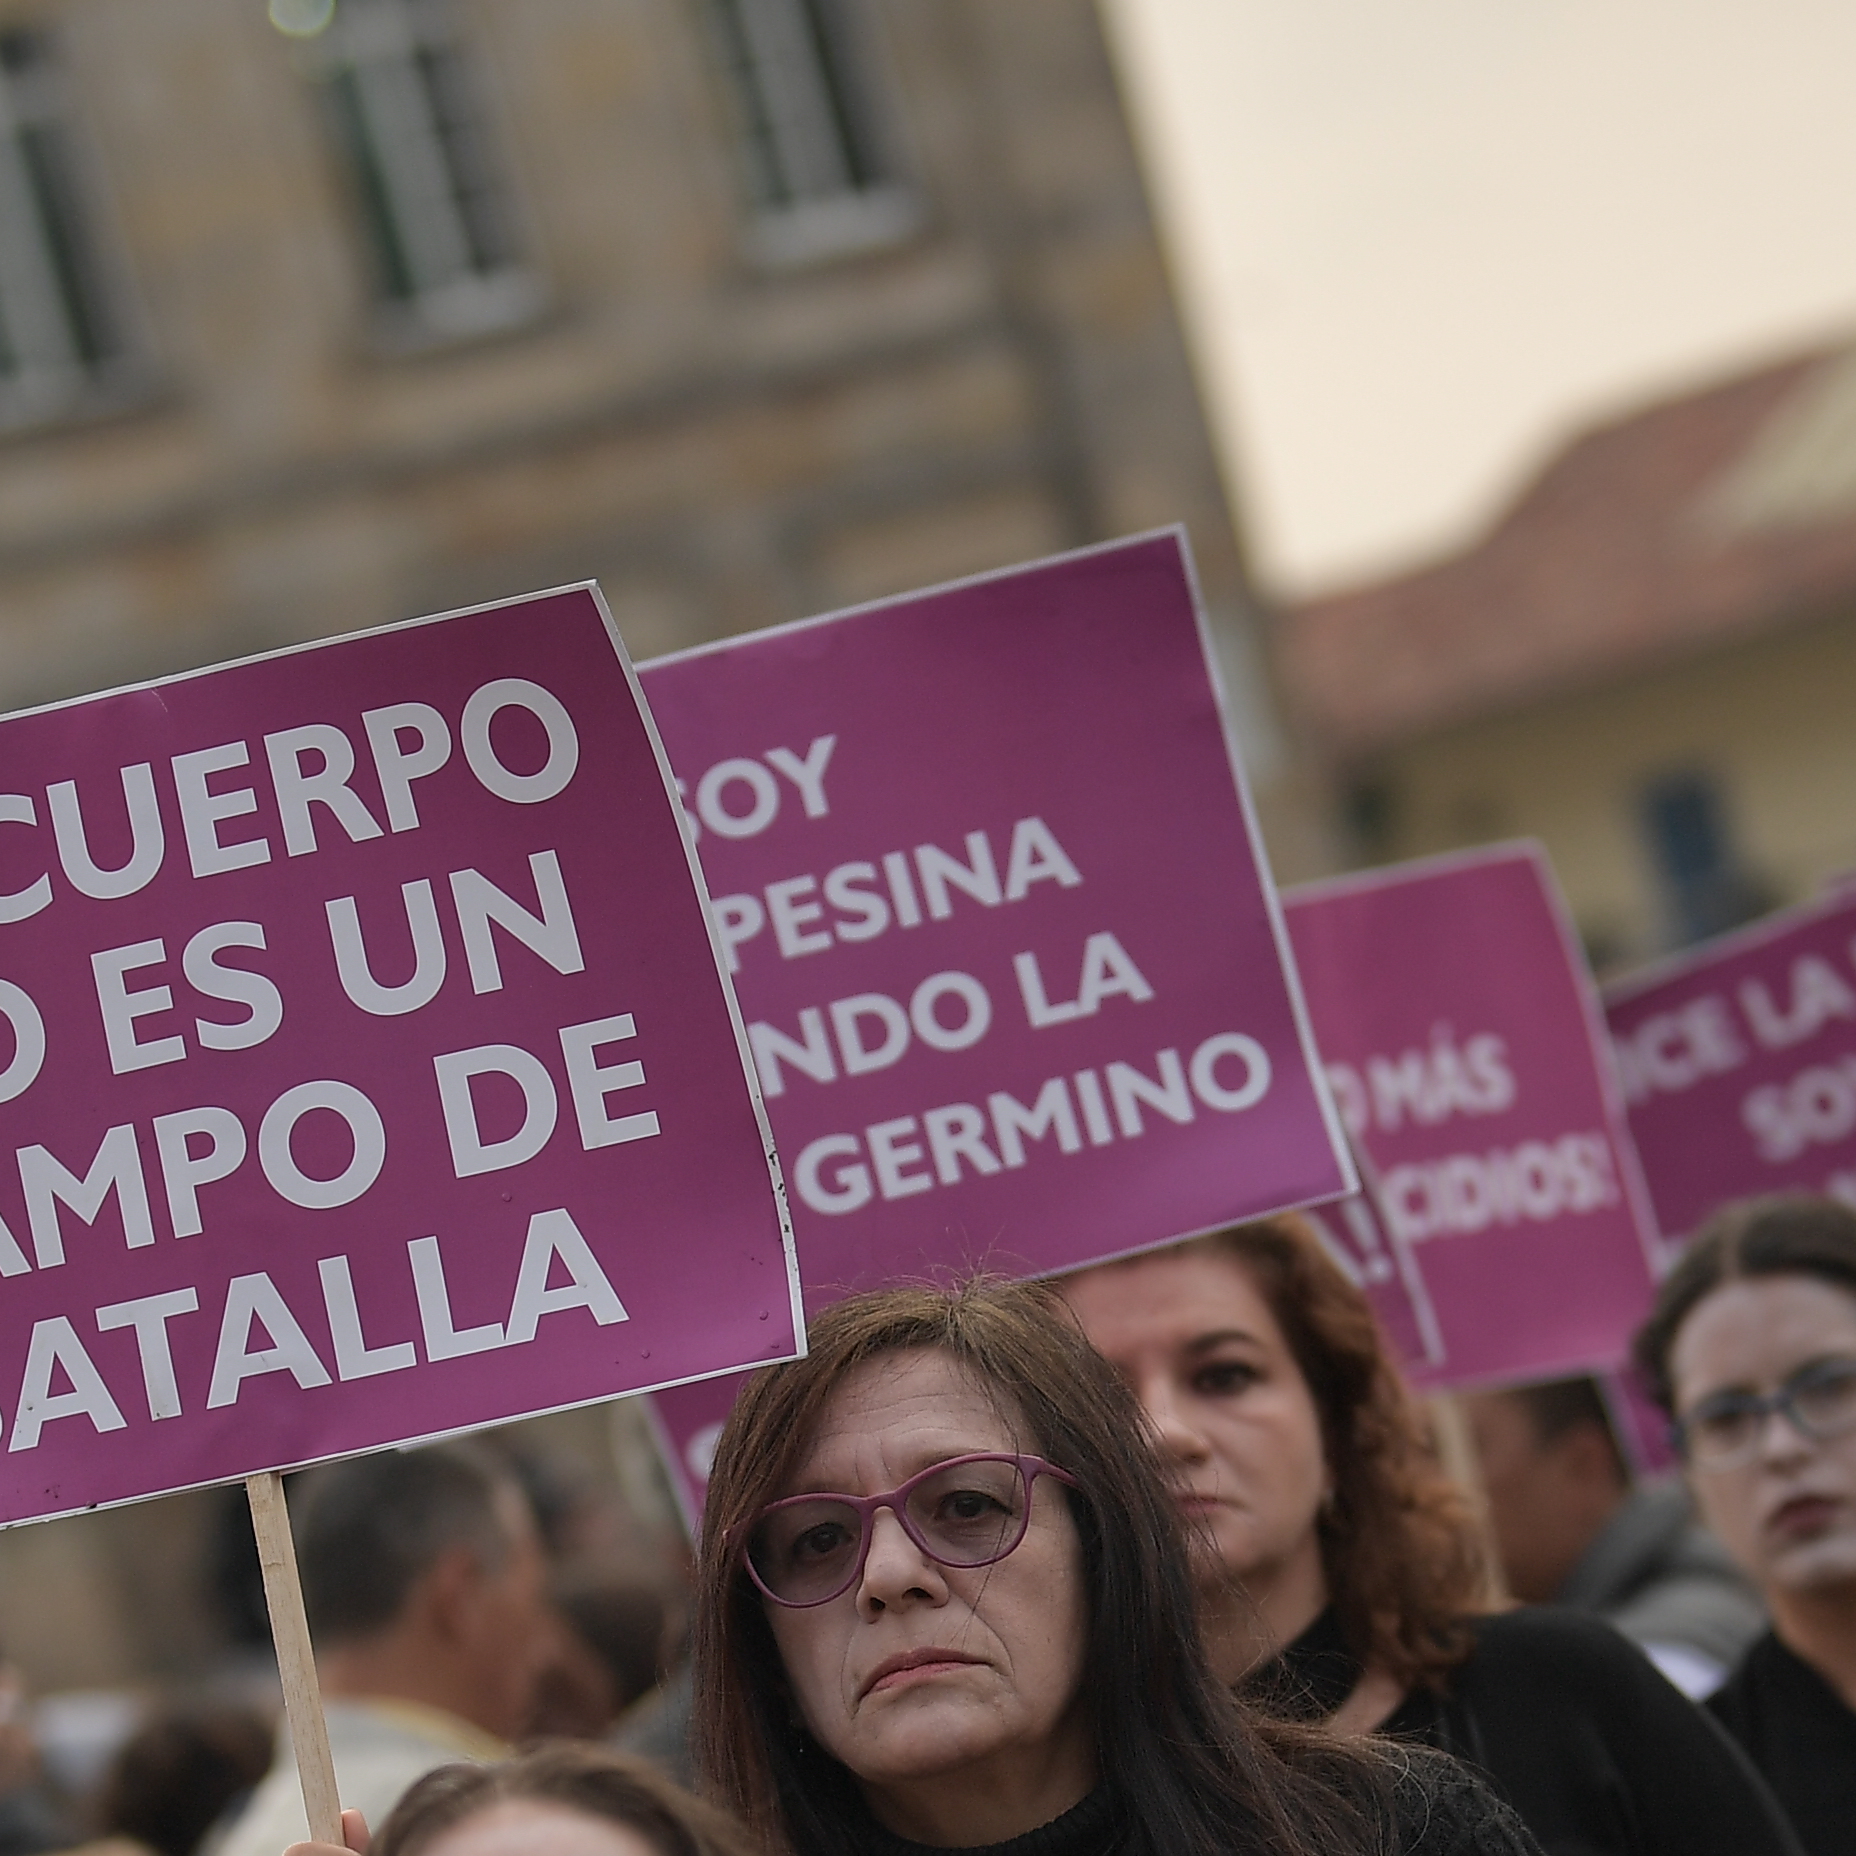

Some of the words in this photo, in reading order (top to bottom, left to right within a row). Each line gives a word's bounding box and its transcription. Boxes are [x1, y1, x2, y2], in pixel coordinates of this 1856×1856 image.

[90, 921, 284, 1076] ES
[324, 849, 586, 1017] UN
[710, 817, 1082, 975] PESINA
[433, 1013, 662, 1181] DE
[747, 970, 993, 1098] NDO
[1014, 932, 1154, 1029] LA
[1365, 1019, 1517, 1133] MÁS
[792, 1031, 1272, 1216] GERMINO
